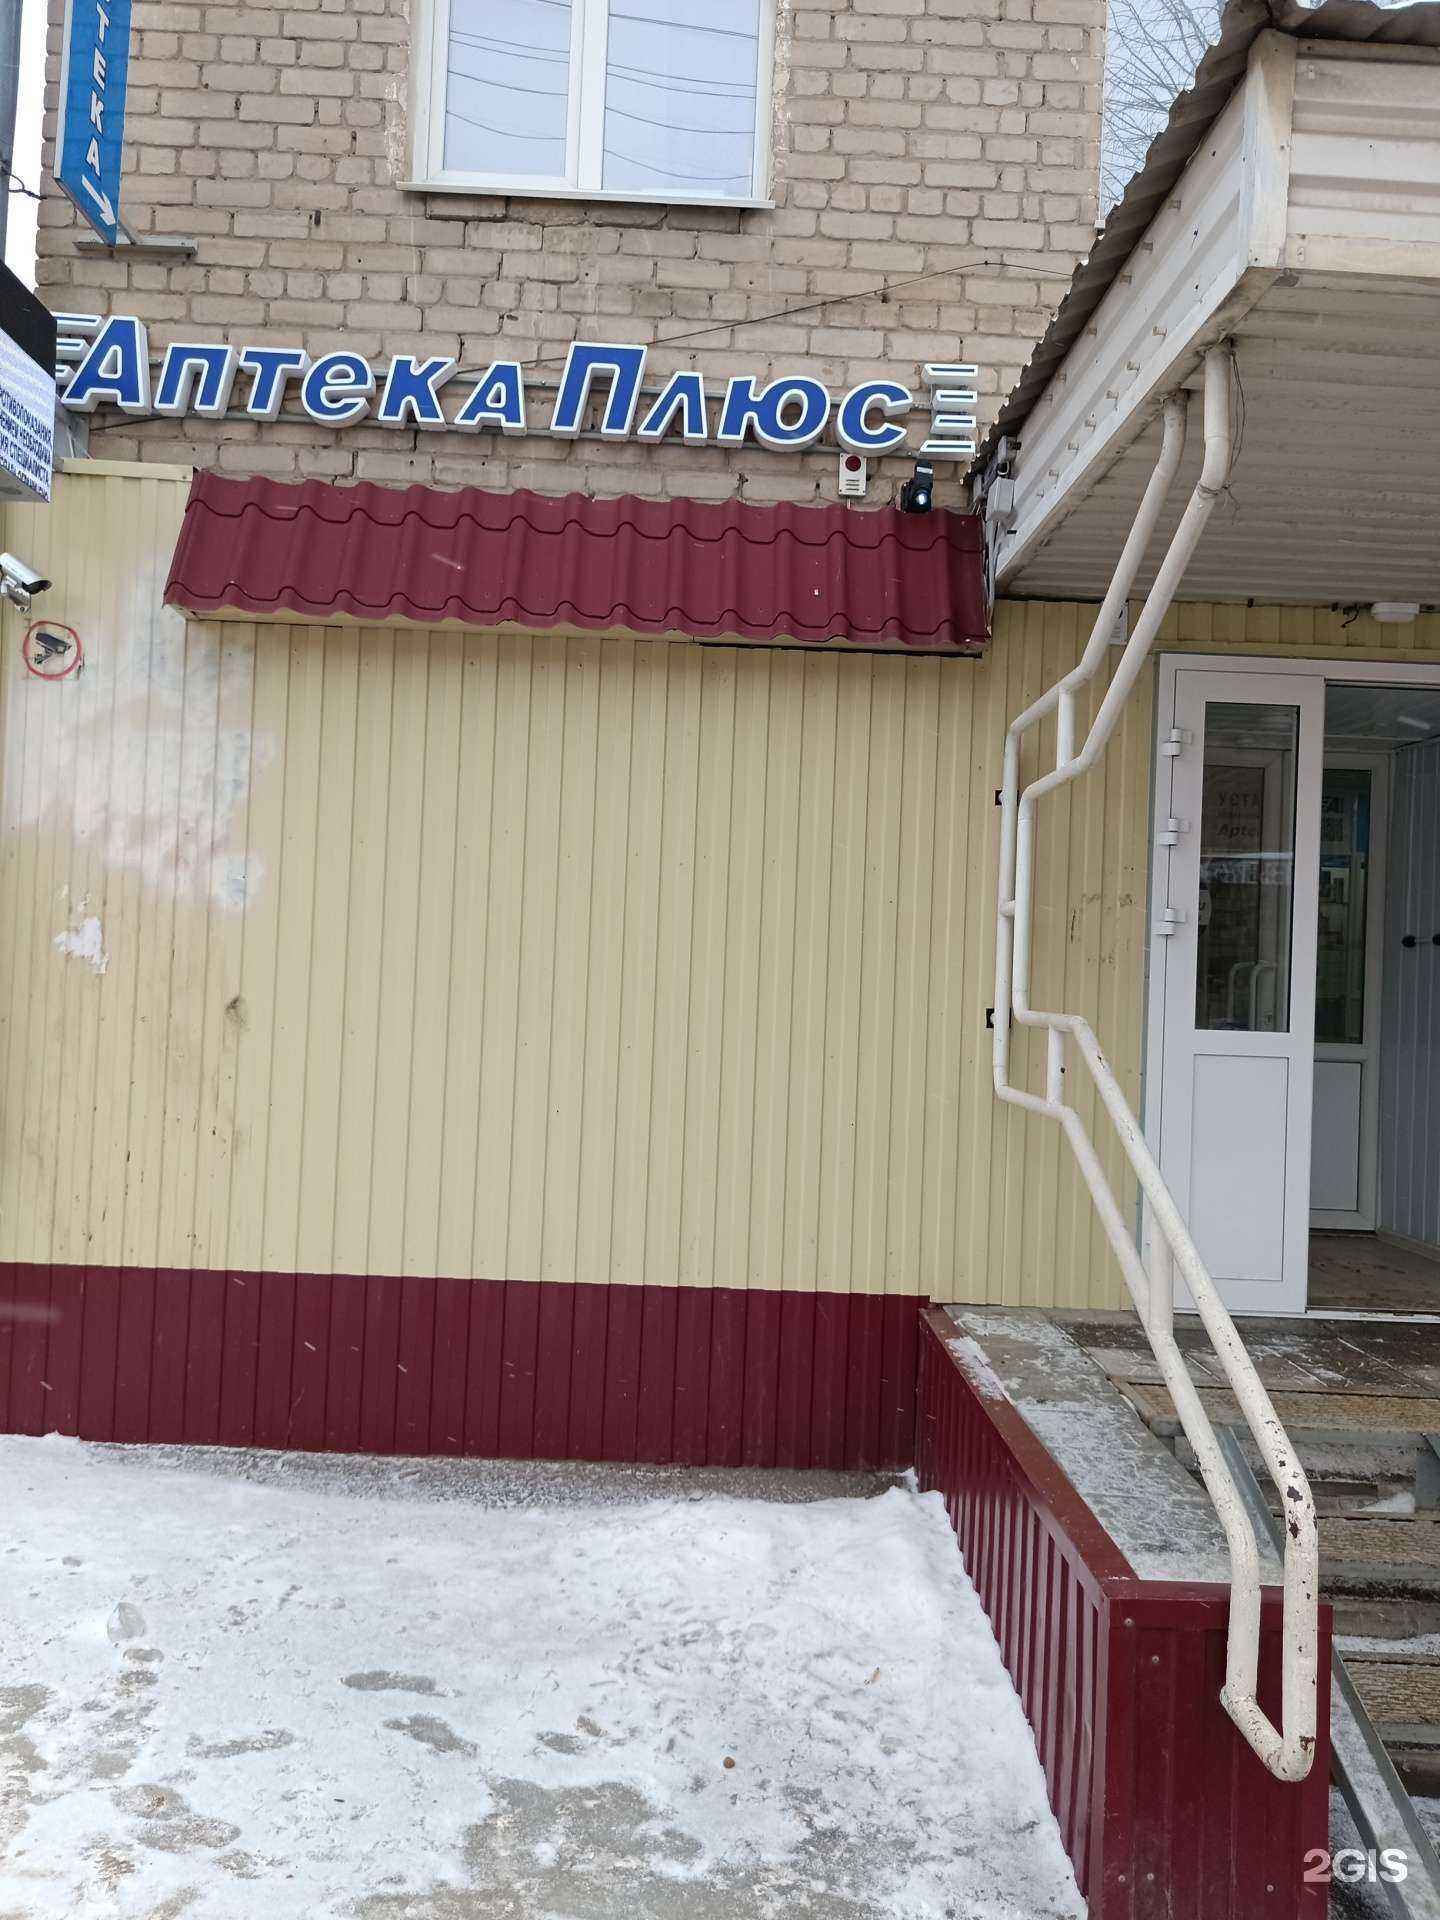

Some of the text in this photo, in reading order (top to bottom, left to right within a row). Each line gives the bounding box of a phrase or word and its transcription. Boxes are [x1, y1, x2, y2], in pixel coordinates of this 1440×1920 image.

[85, 0, 110, 176] ТЕКА
[59, 315, 913, 456] Аптека Плюс
